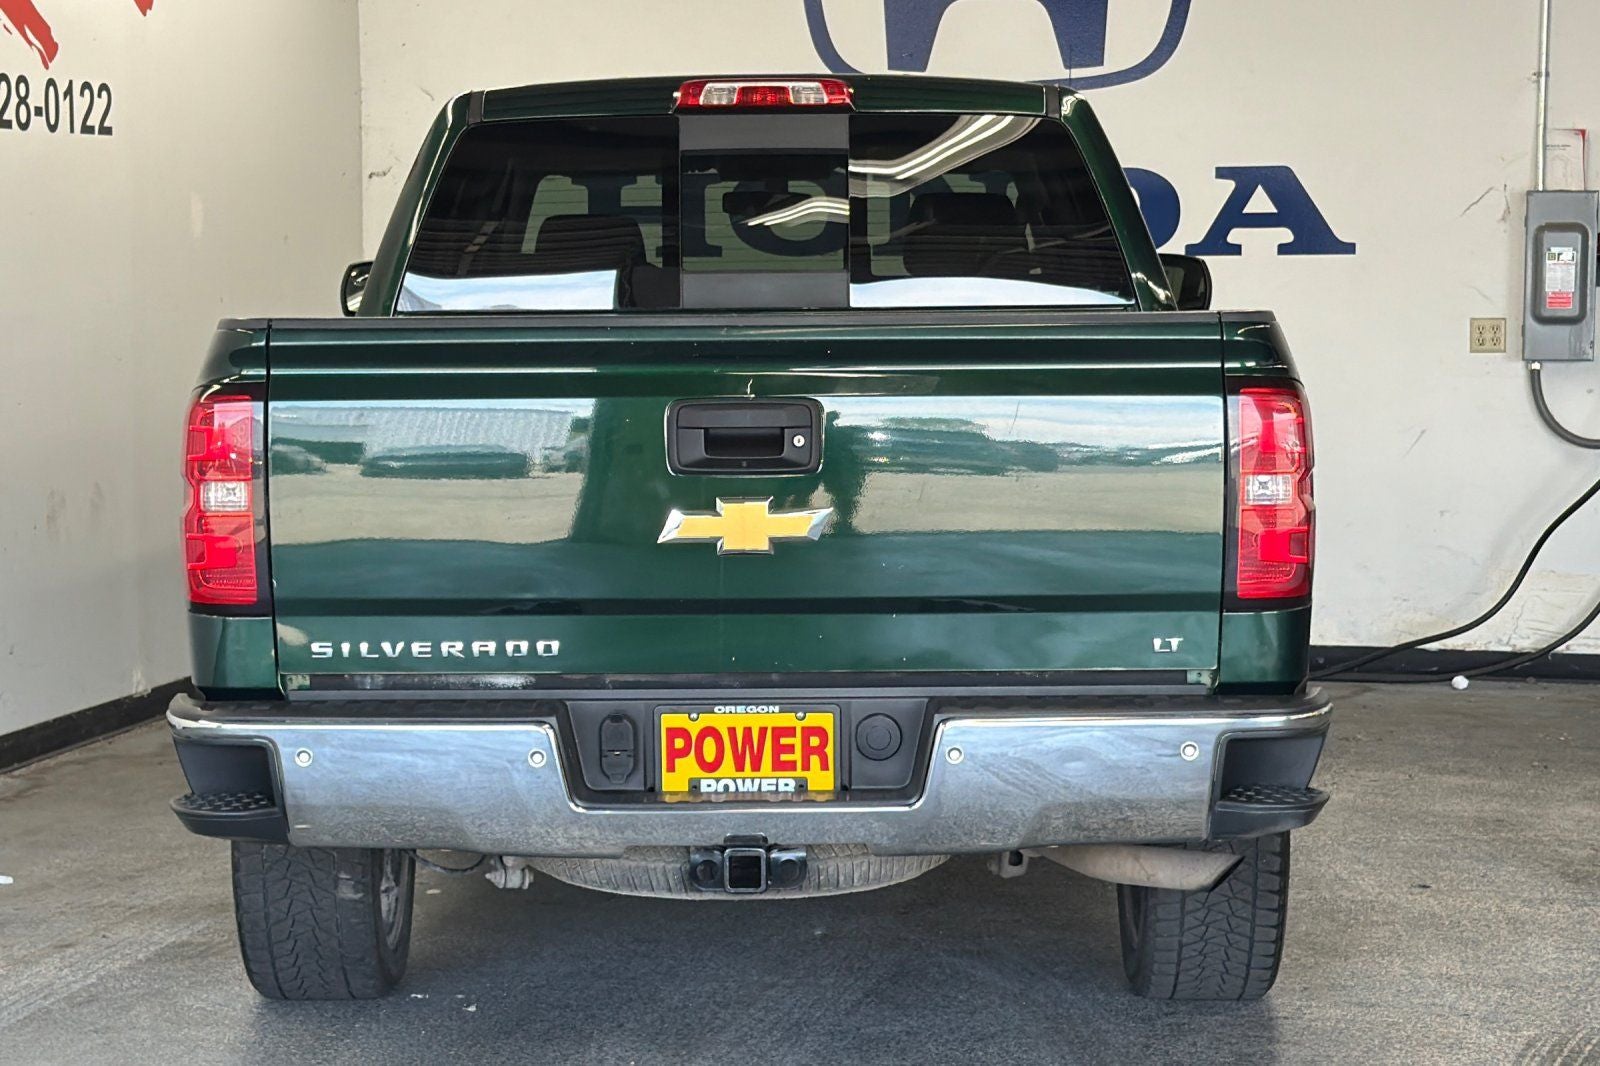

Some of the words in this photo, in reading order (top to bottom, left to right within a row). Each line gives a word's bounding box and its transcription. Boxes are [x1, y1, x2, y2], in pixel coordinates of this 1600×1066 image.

[0, 73, 113, 136] 28-0122
[310, 640, 560, 658] SILVERADO
[1153, 637, 1184, 653] LT
[713, 705, 780, 714] OREGON
[665, 725, 830, 774] POWER
[700, 778, 796, 793] POWER
